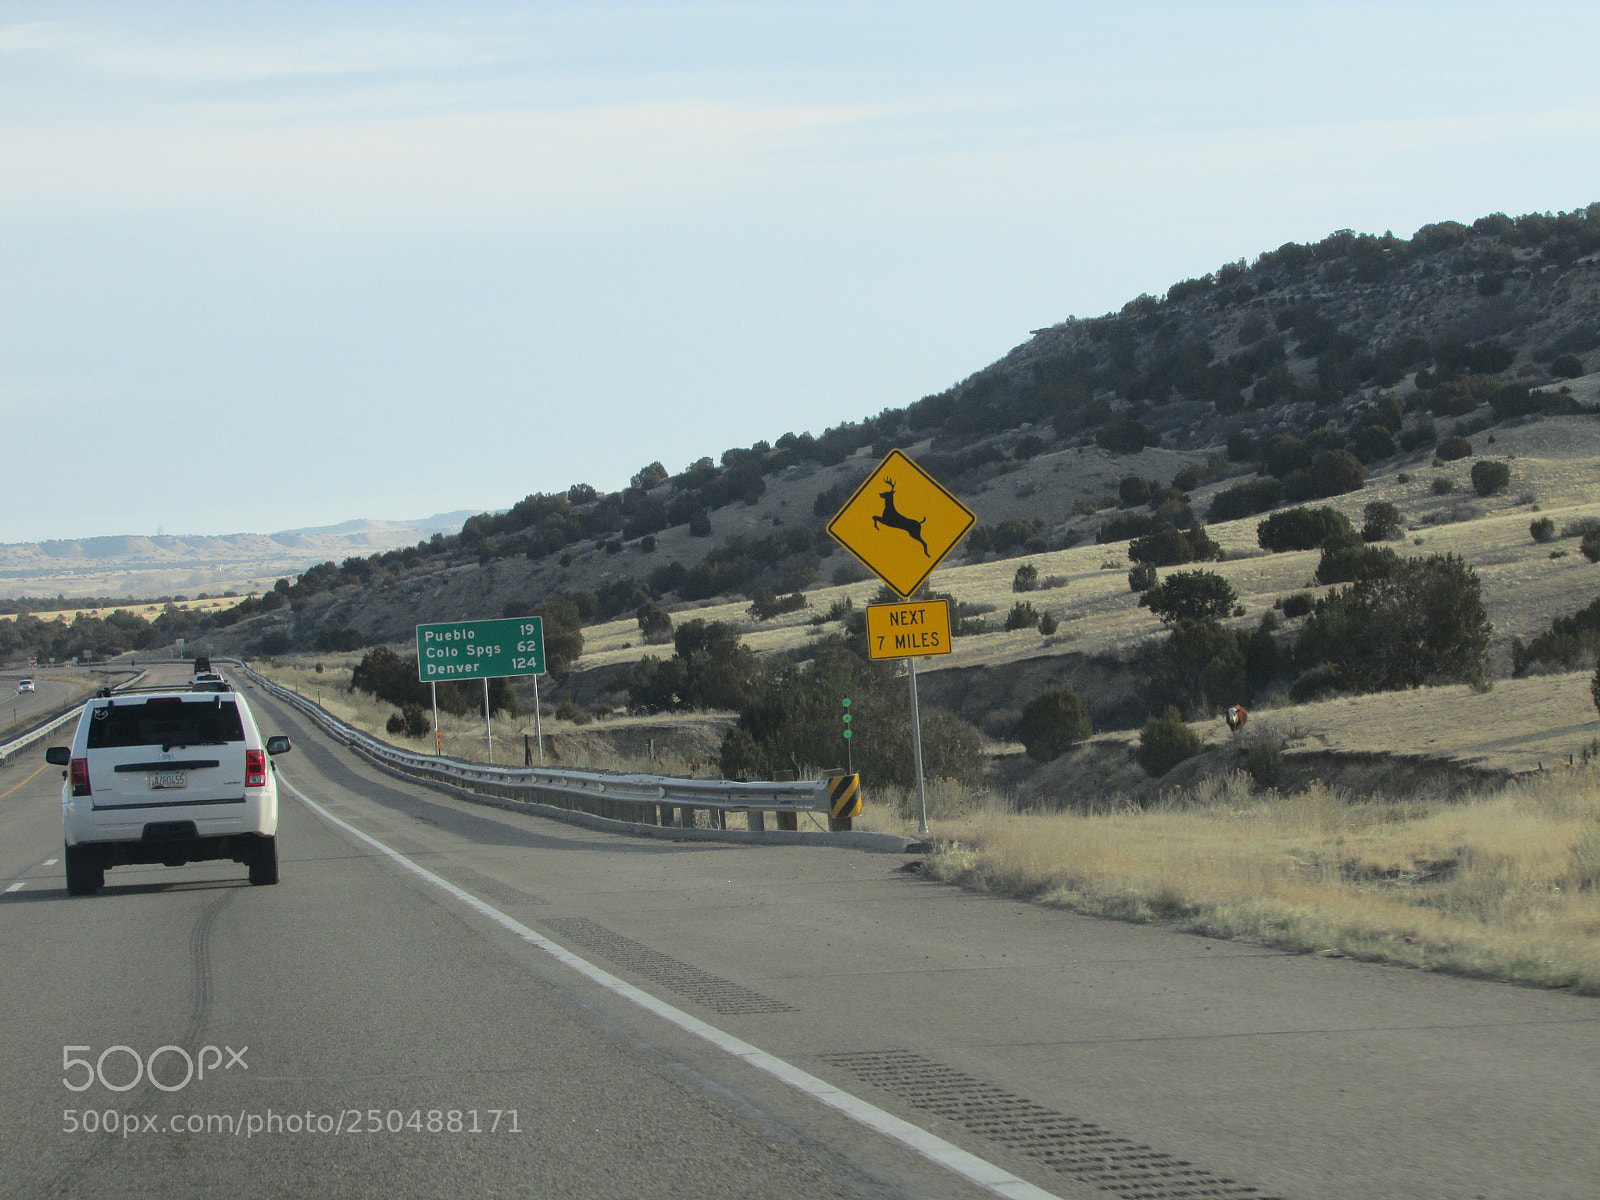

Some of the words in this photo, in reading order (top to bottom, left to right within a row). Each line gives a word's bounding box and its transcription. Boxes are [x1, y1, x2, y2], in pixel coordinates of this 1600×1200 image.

[889, 609, 926, 627] NEXT
[424, 629, 475, 642] Pueblo
[519, 623, 535, 635] 19
[876, 635, 885, 651] 7
[895, 631, 940, 650] MILES
[426, 646, 459, 658] Colo
[466, 644, 502, 657] Spgs
[516, 640, 536, 652] 62
[426, 663, 480, 675] Denver
[511, 656, 537, 669] 124
